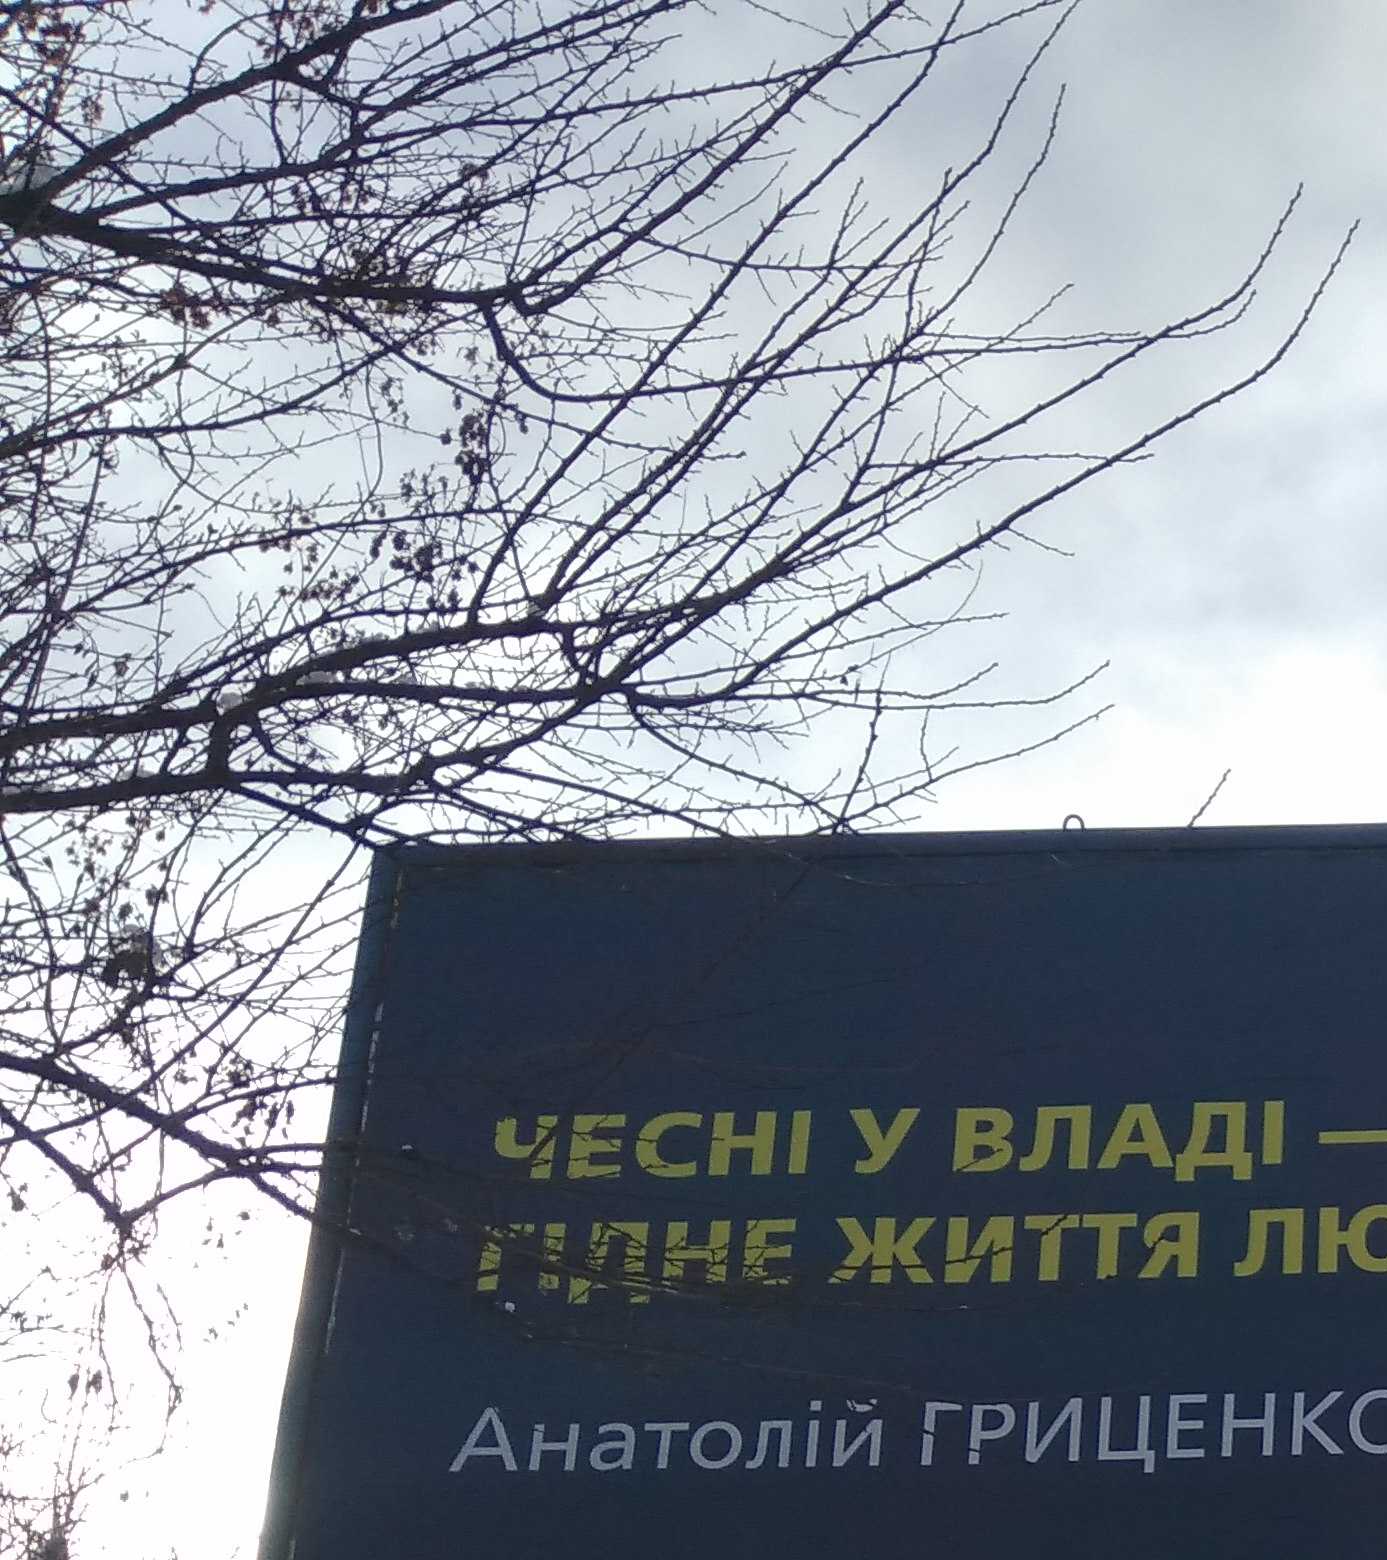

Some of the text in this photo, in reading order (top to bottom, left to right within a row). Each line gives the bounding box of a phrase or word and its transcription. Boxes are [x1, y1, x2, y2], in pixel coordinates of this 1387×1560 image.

[494, 1109, 811, 1180] ЧЕСНІ
[849, 1107, 921, 1175] У
[952, 1100, 1285, 1182] ВЛАДІ
[476, 1218, 796, 1305] ГІДНЕ
[827, 1211, 1200, 1286] ЖИТТЯ
[448, 1399, 884, 1472] Анатолій
